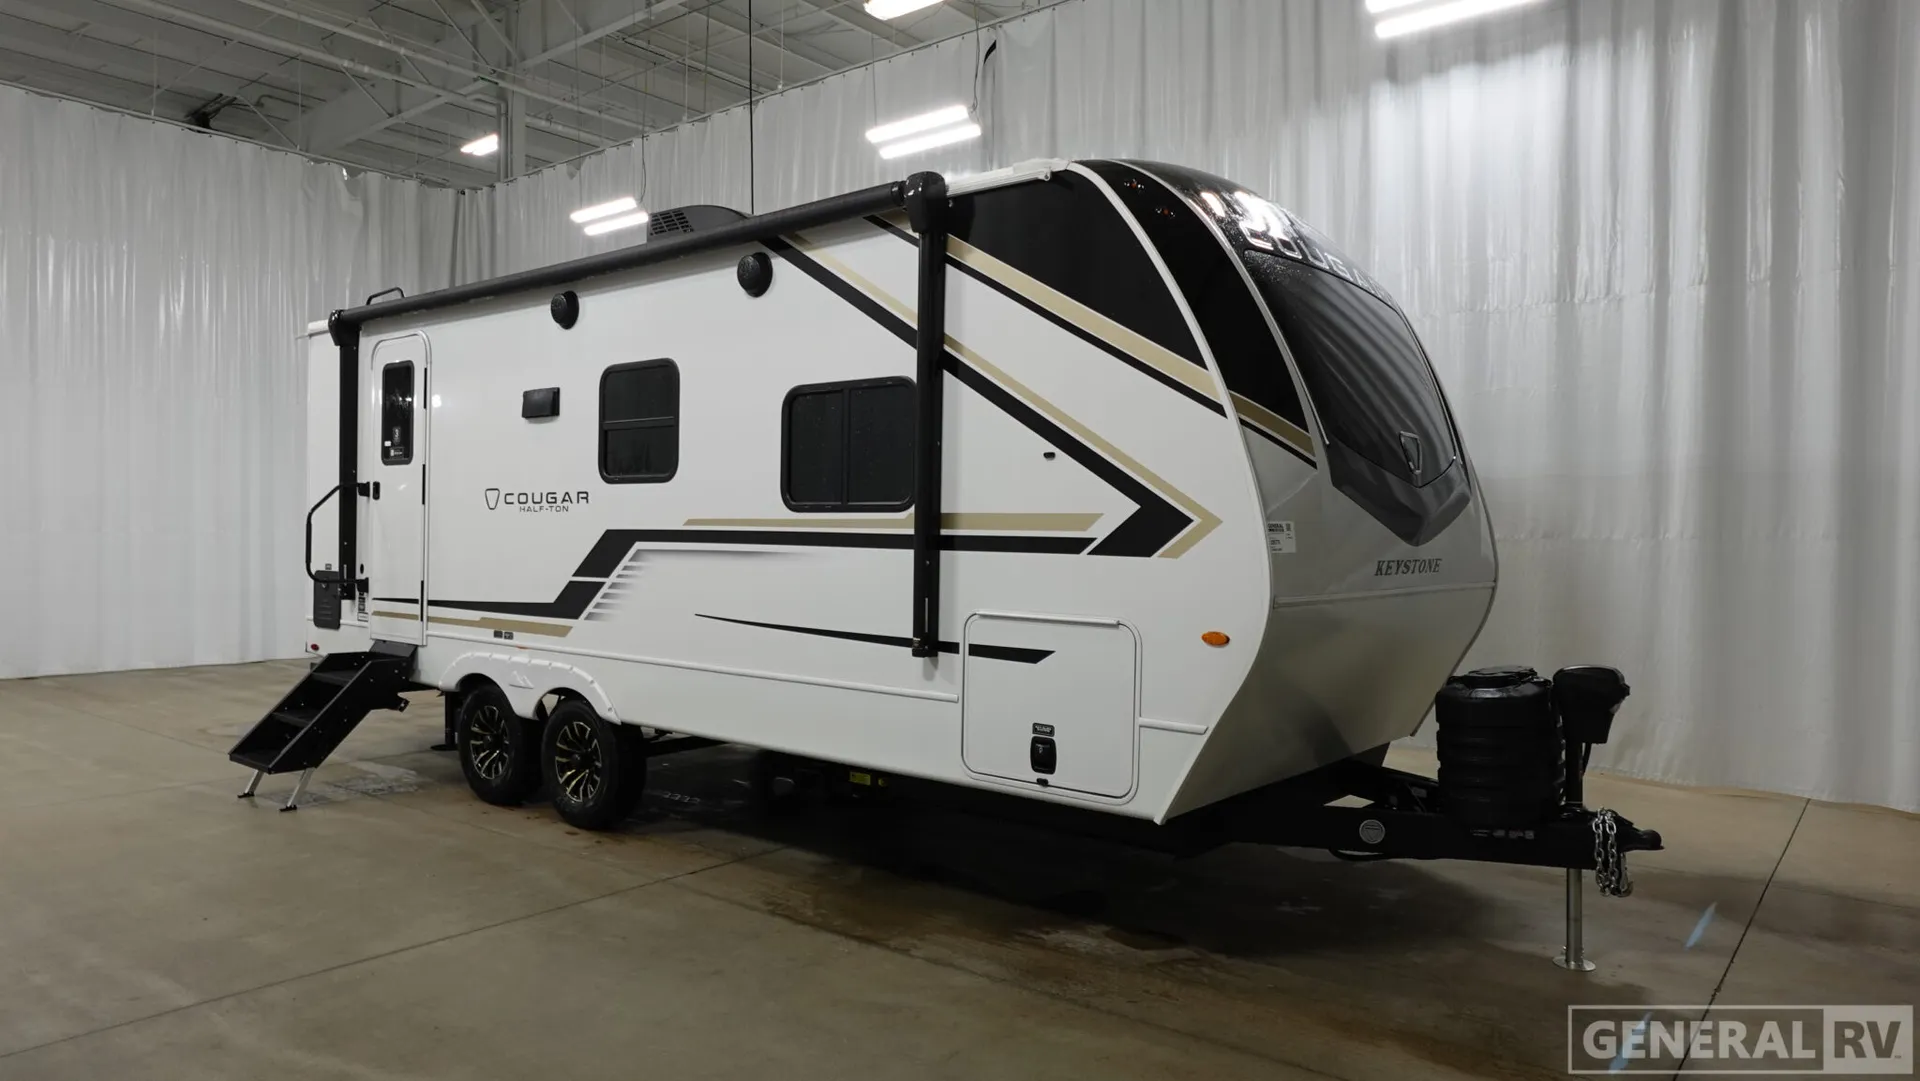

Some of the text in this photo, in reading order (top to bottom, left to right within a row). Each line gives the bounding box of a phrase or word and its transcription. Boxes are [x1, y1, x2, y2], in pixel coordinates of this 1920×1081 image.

[504, 491, 589, 505] COUGAR
[519, 505, 570, 513] HALF-TON
[1374, 558, 1443, 577] KEYSTONE
